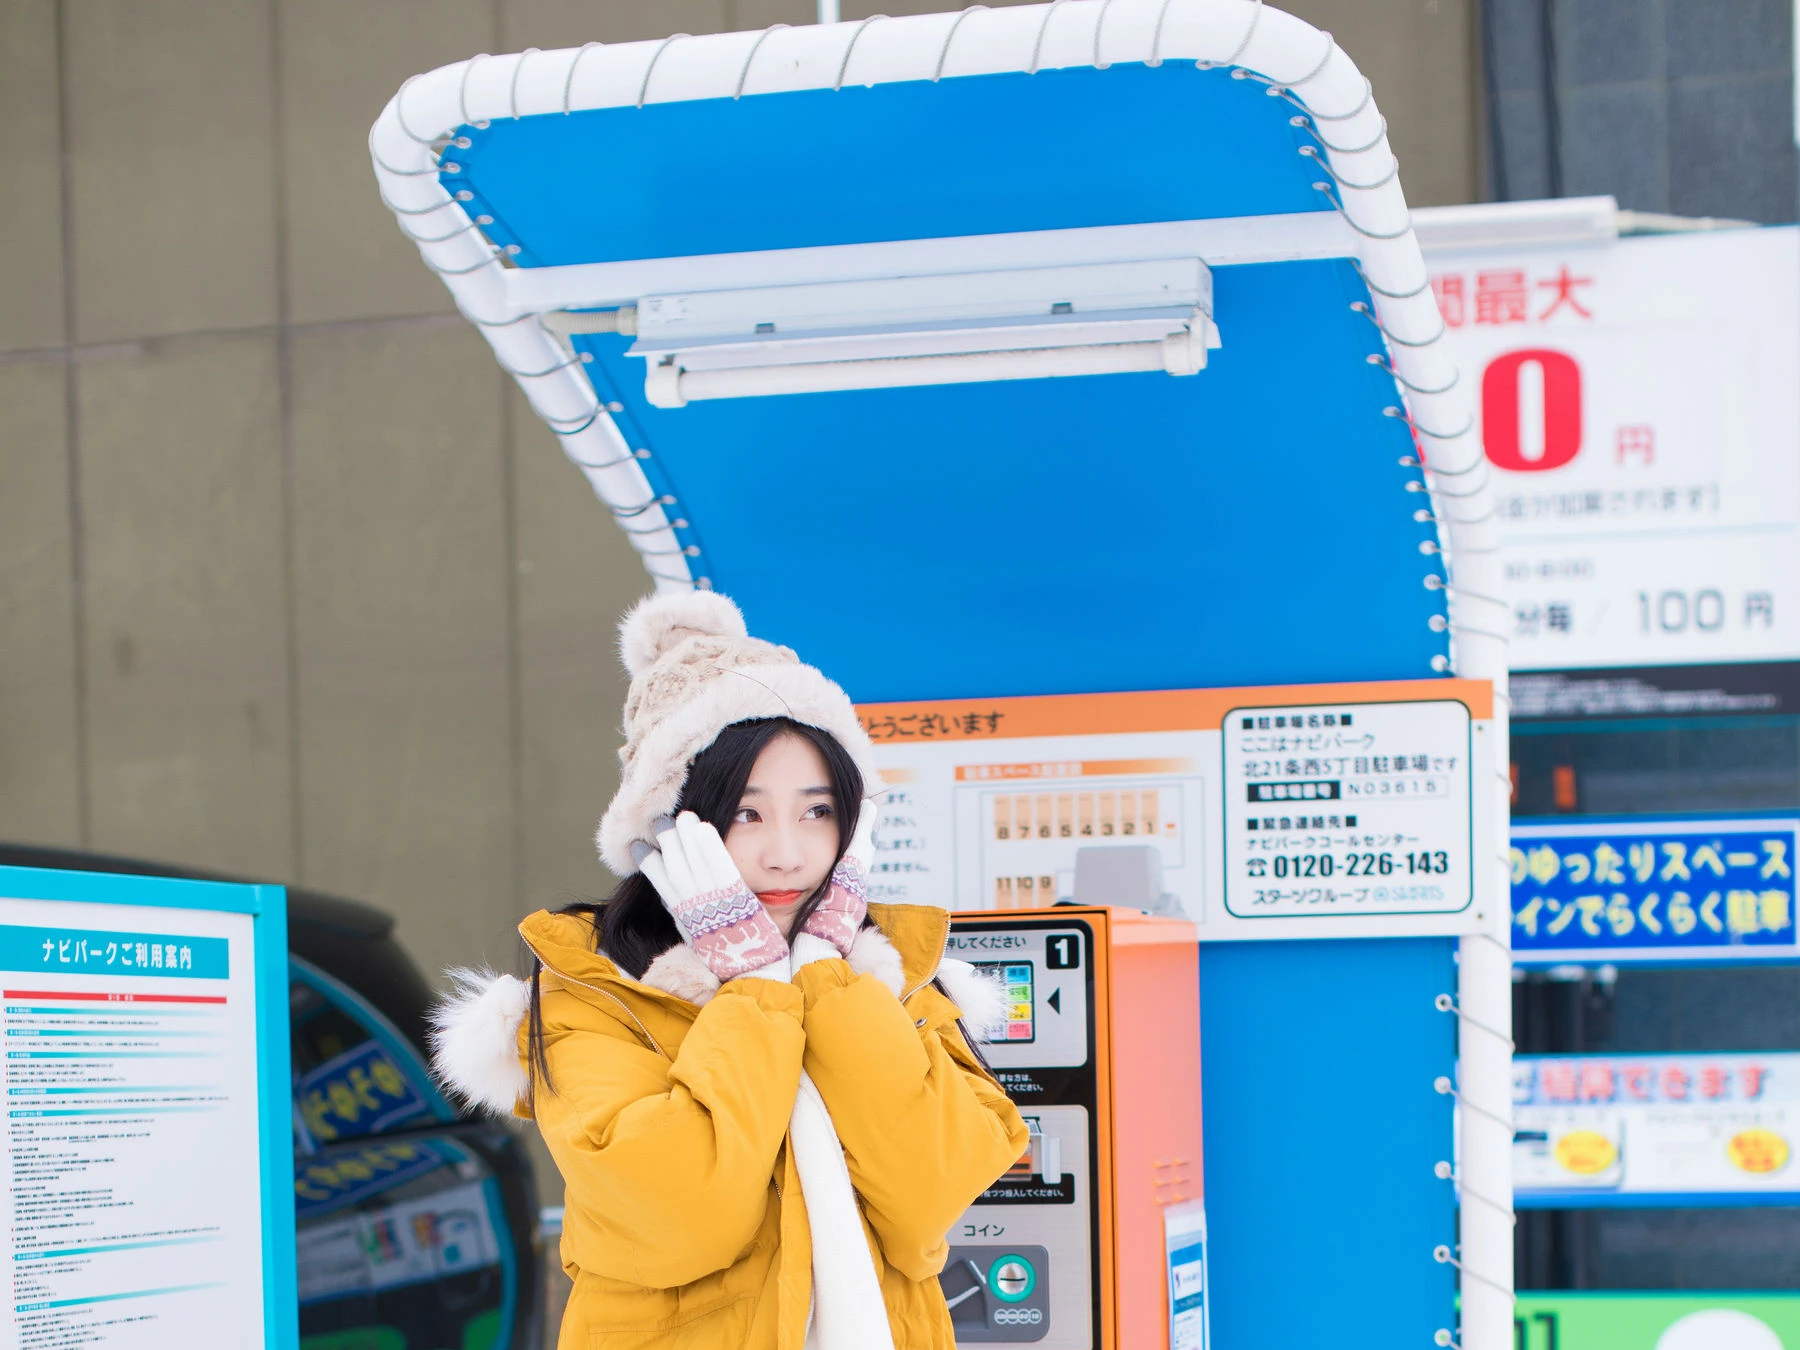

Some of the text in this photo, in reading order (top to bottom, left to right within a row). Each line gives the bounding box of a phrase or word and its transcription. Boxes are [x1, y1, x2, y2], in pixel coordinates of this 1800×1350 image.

[1639, 589, 1725, 634] 100
[857, 710, 1005, 738] とうございます
[997, 821, 1154, 840] 8 7 6 5 4 3 2 1
[1274, 851, 1449, 878] 0120-226-143
[996, 876, 1052, 889] 11 10 9
[42, 938, 193, 970] ナビパークご利用案内
[1055, 938, 1068, 966] 1
[1006, 1084, 1043, 1092] てください。
[964, 1224, 1005, 1237] コイン
